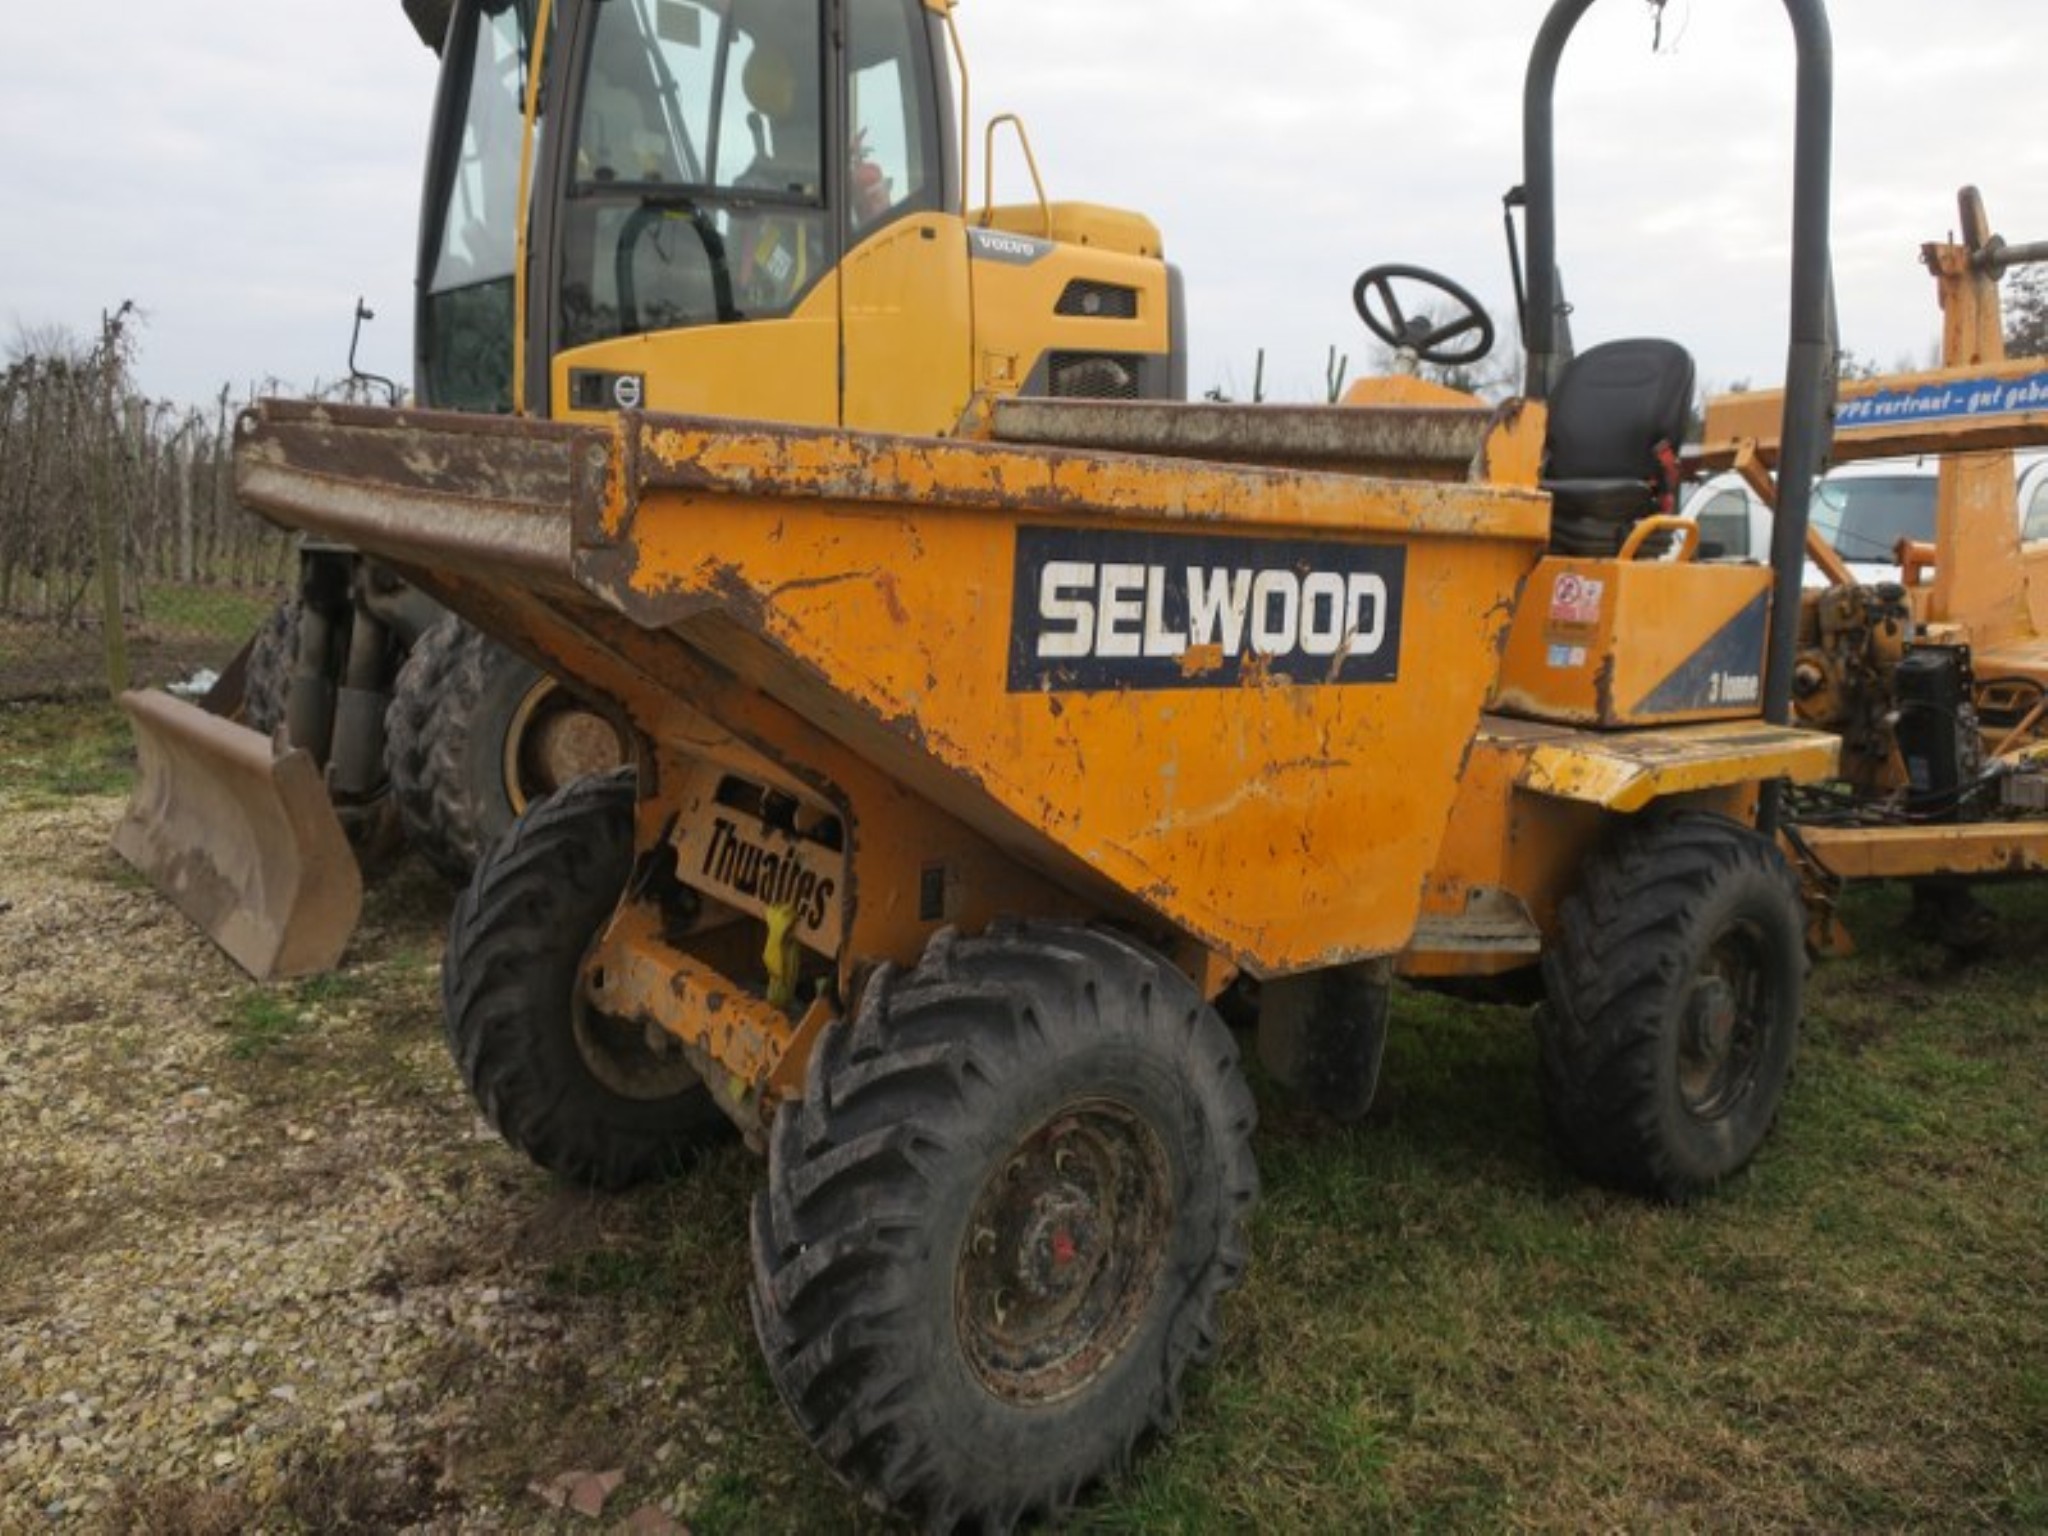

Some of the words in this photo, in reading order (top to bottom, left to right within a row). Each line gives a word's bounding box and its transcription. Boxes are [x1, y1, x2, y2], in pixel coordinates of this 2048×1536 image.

[979, 235, 1034, 256] VOLVO
[1874, 390, 1951, 416] vertraut
[1967, 385, 2002, 412] gut
[1037, 560, 1388, 657] SELWOOD
[1708, 671, 1720, 703] 3
[1722, 670, 1759, 702] tonne
[702, 816, 835, 920] Thwaites
